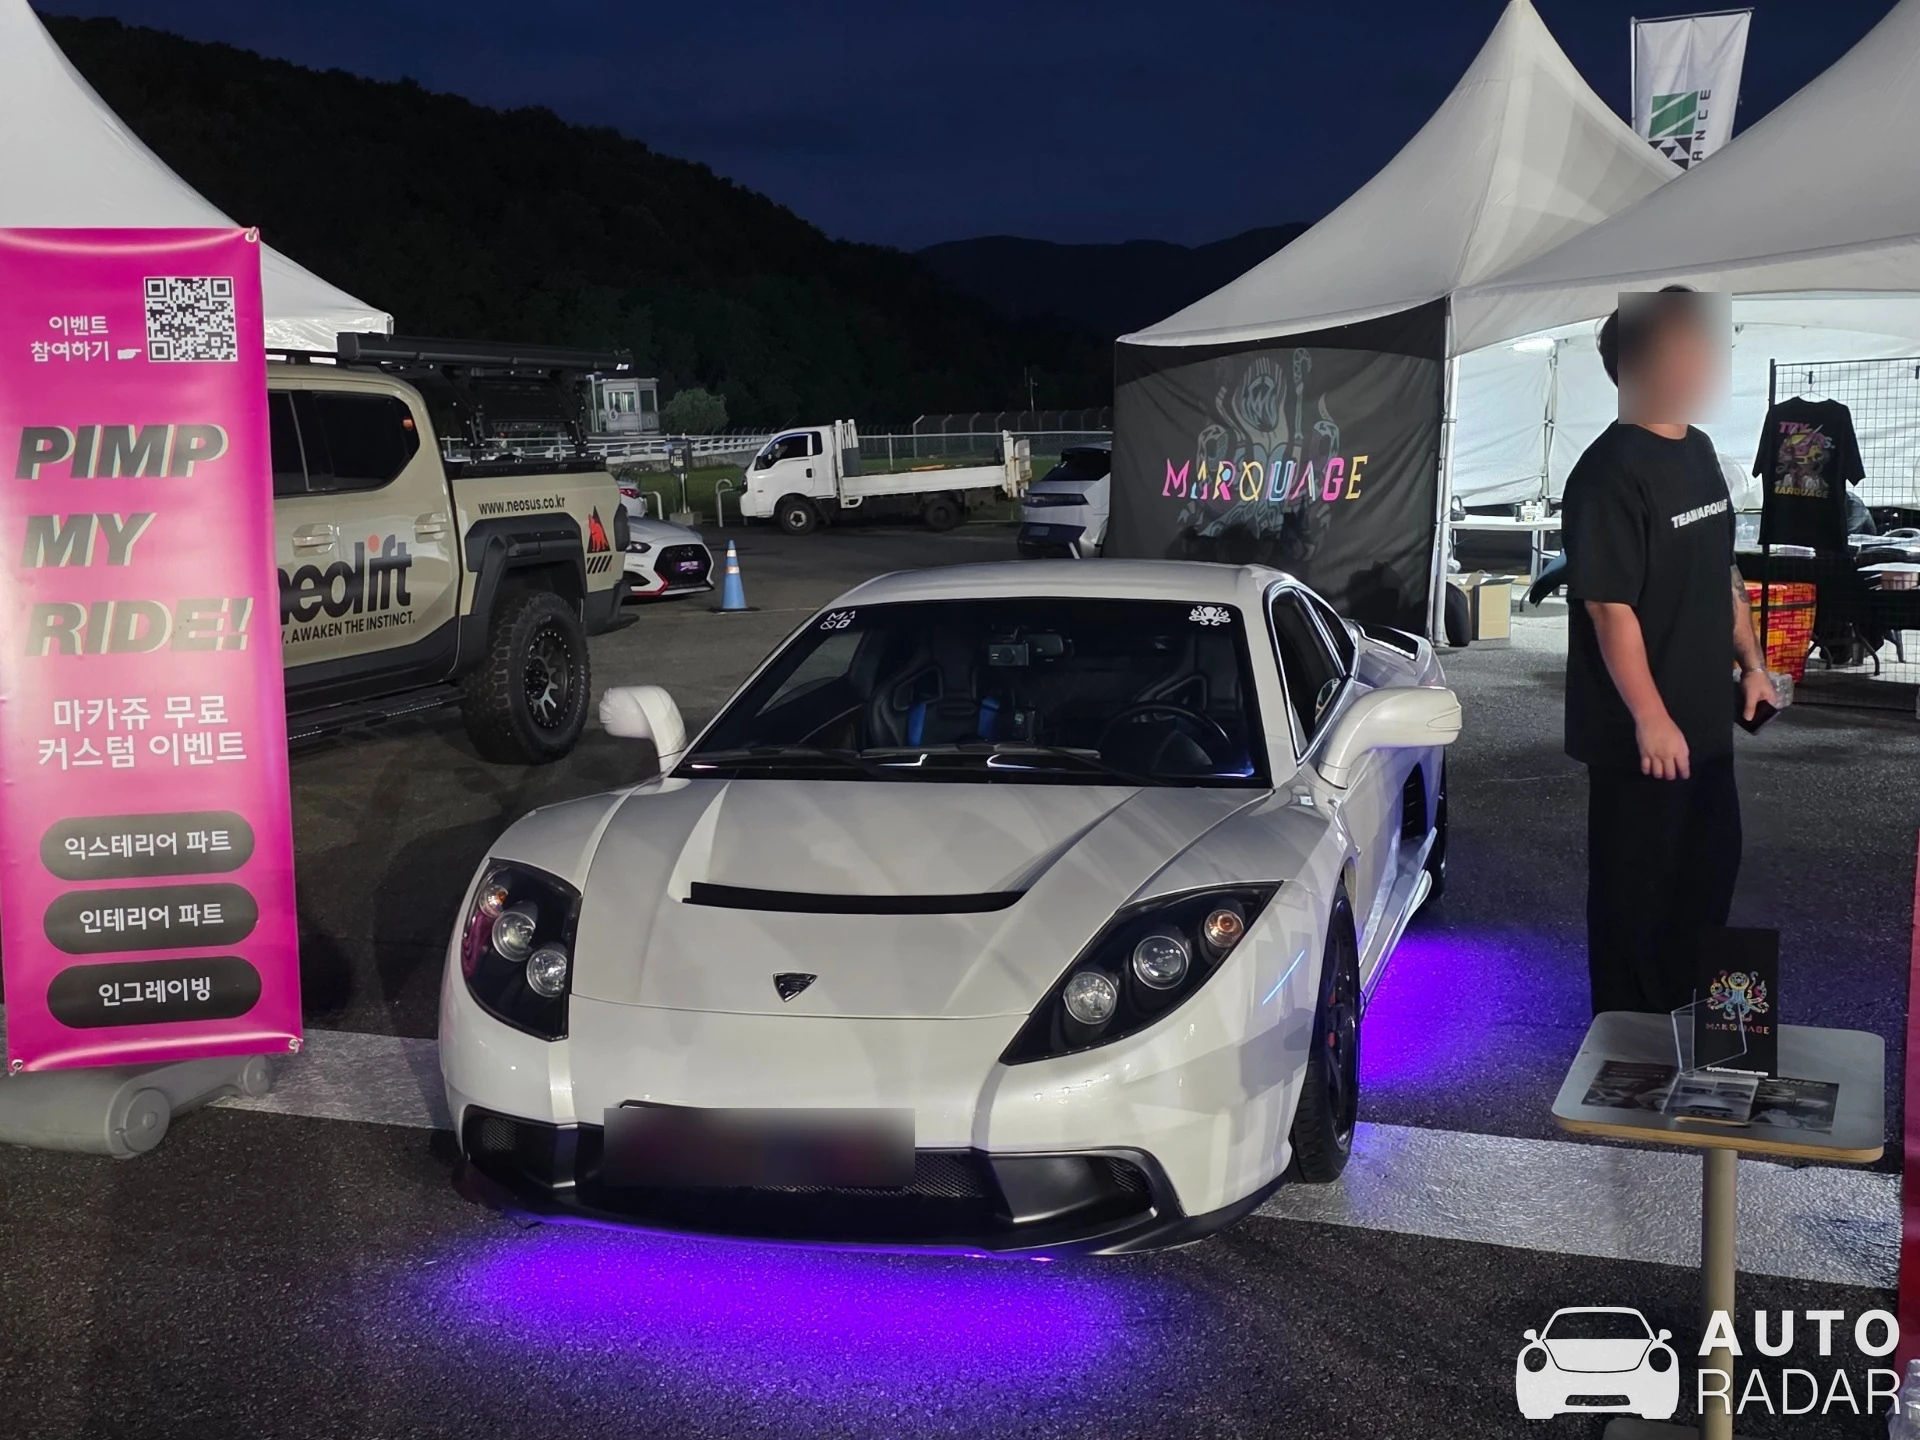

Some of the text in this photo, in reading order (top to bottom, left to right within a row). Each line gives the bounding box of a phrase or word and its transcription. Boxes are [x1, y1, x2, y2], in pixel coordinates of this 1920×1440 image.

[49, 315, 109, 336] 이벤트
[31, 340, 109, 362] 참여하기
[15, 424, 229, 480] PIMP
[1162, 455, 1369, 502] MARQUAGE
[478, 494, 566, 515] www.neosus.co.kr
[20, 512, 157, 568] MY
[25, 597, 254, 657] RIDE!
[291, 623, 343, 643] AWAKEN
[345, 619, 365, 634] THE
[366, 611, 416, 631] INSTINCT.
[54, 695, 229, 732] 마카쥬 무료
[39, 731, 247, 770] 커스텀 이벤트
[64, 829, 232, 860] 익스테리어 파트
[79, 903, 224, 934] 인테리어 파트
[99, 977, 211, 1007] 인그레이빙
